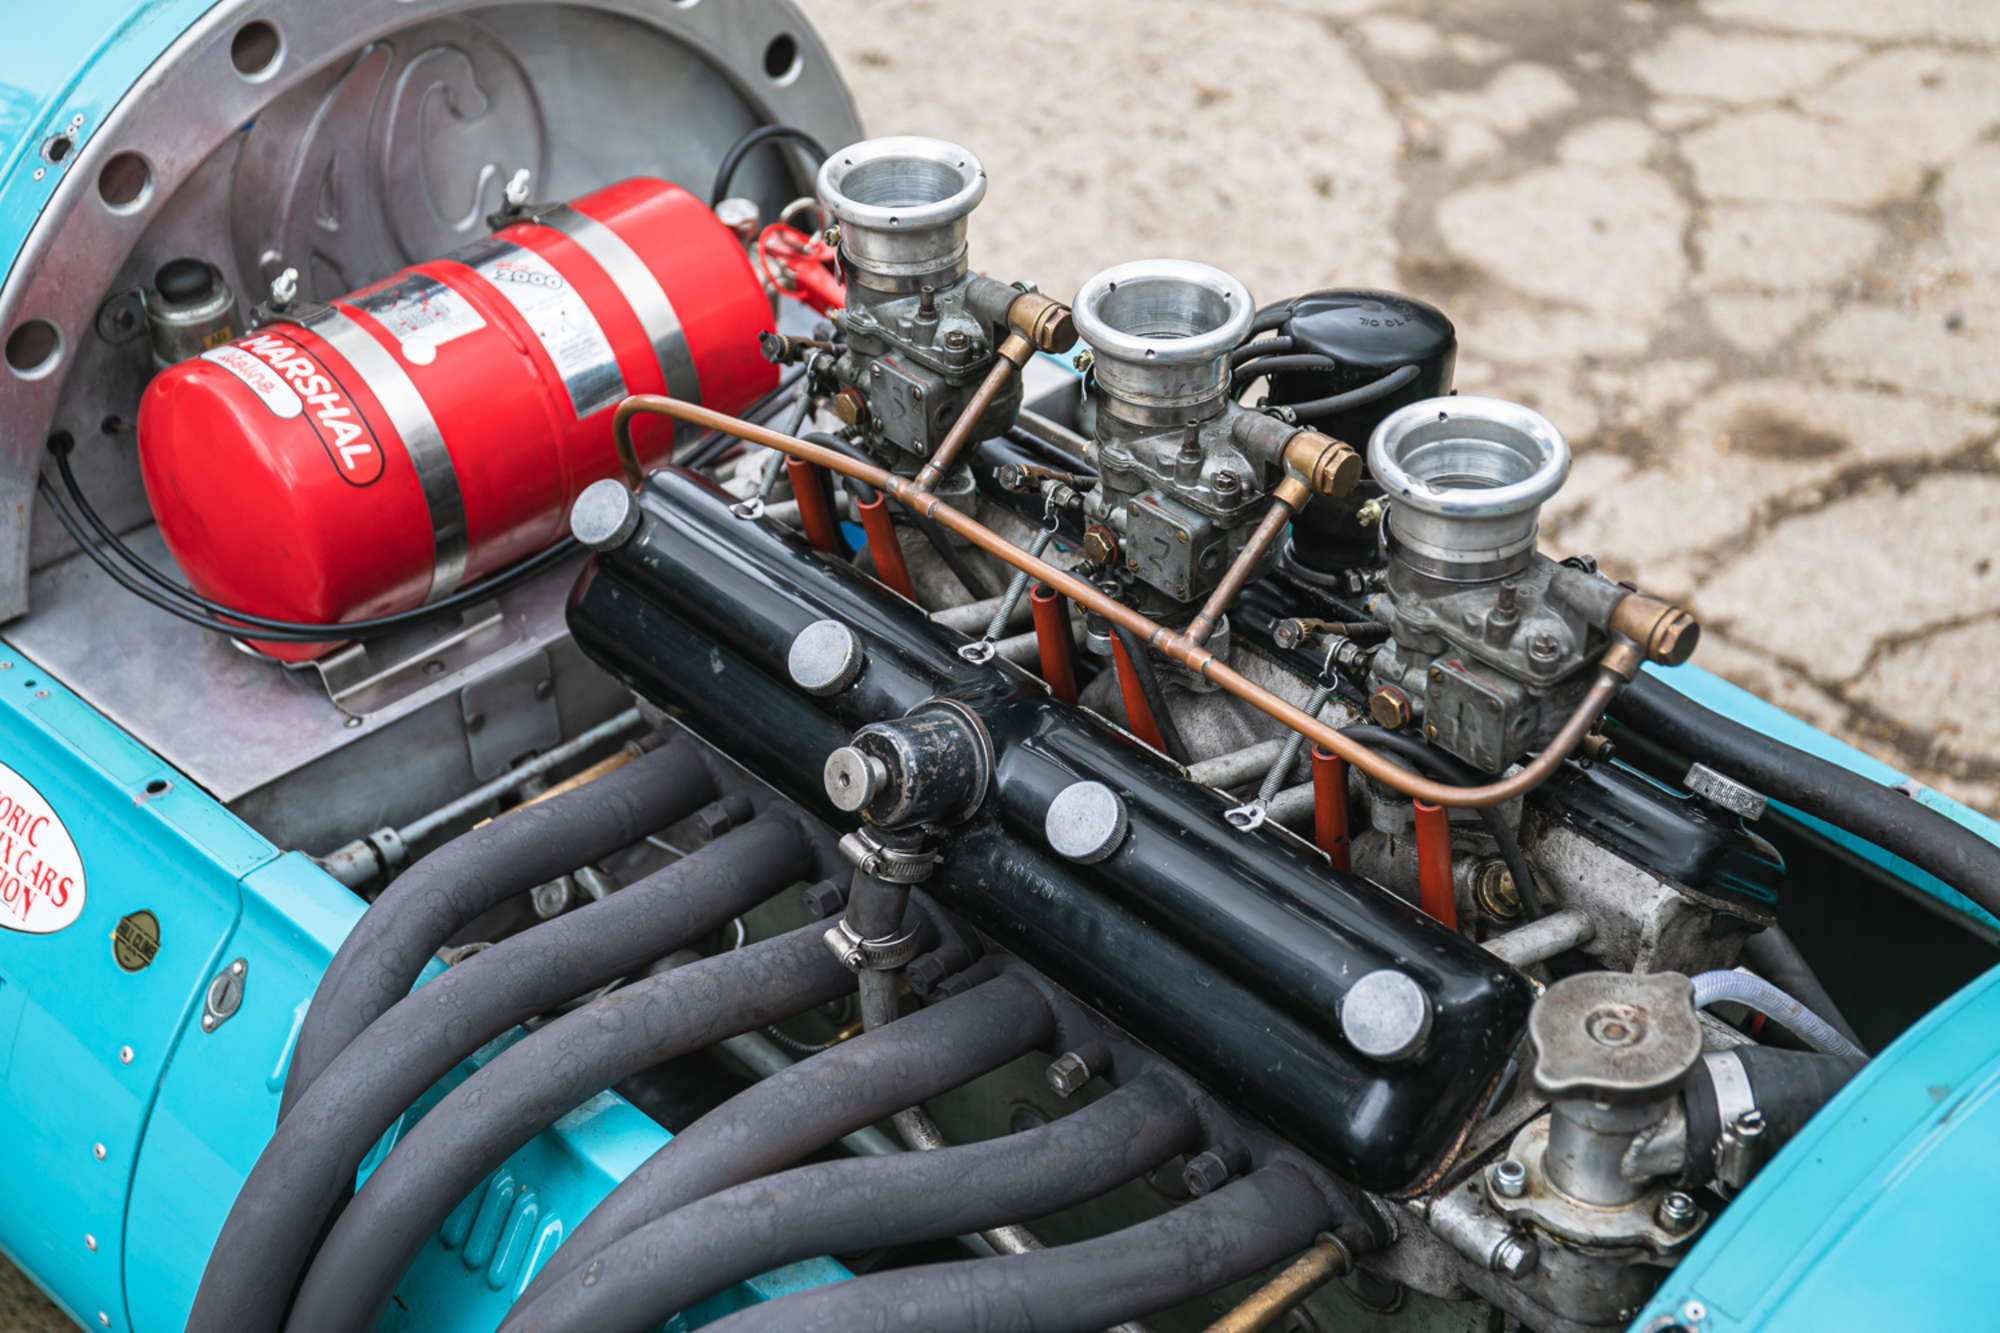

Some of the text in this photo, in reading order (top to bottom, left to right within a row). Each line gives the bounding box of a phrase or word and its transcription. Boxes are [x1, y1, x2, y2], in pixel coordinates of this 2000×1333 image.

[494, 269, 563, 290] 2000
[239, 334, 371, 470] MARSHAL
[0, 867, 37, 922] ION
[16, 849, 74, 908] CARS
